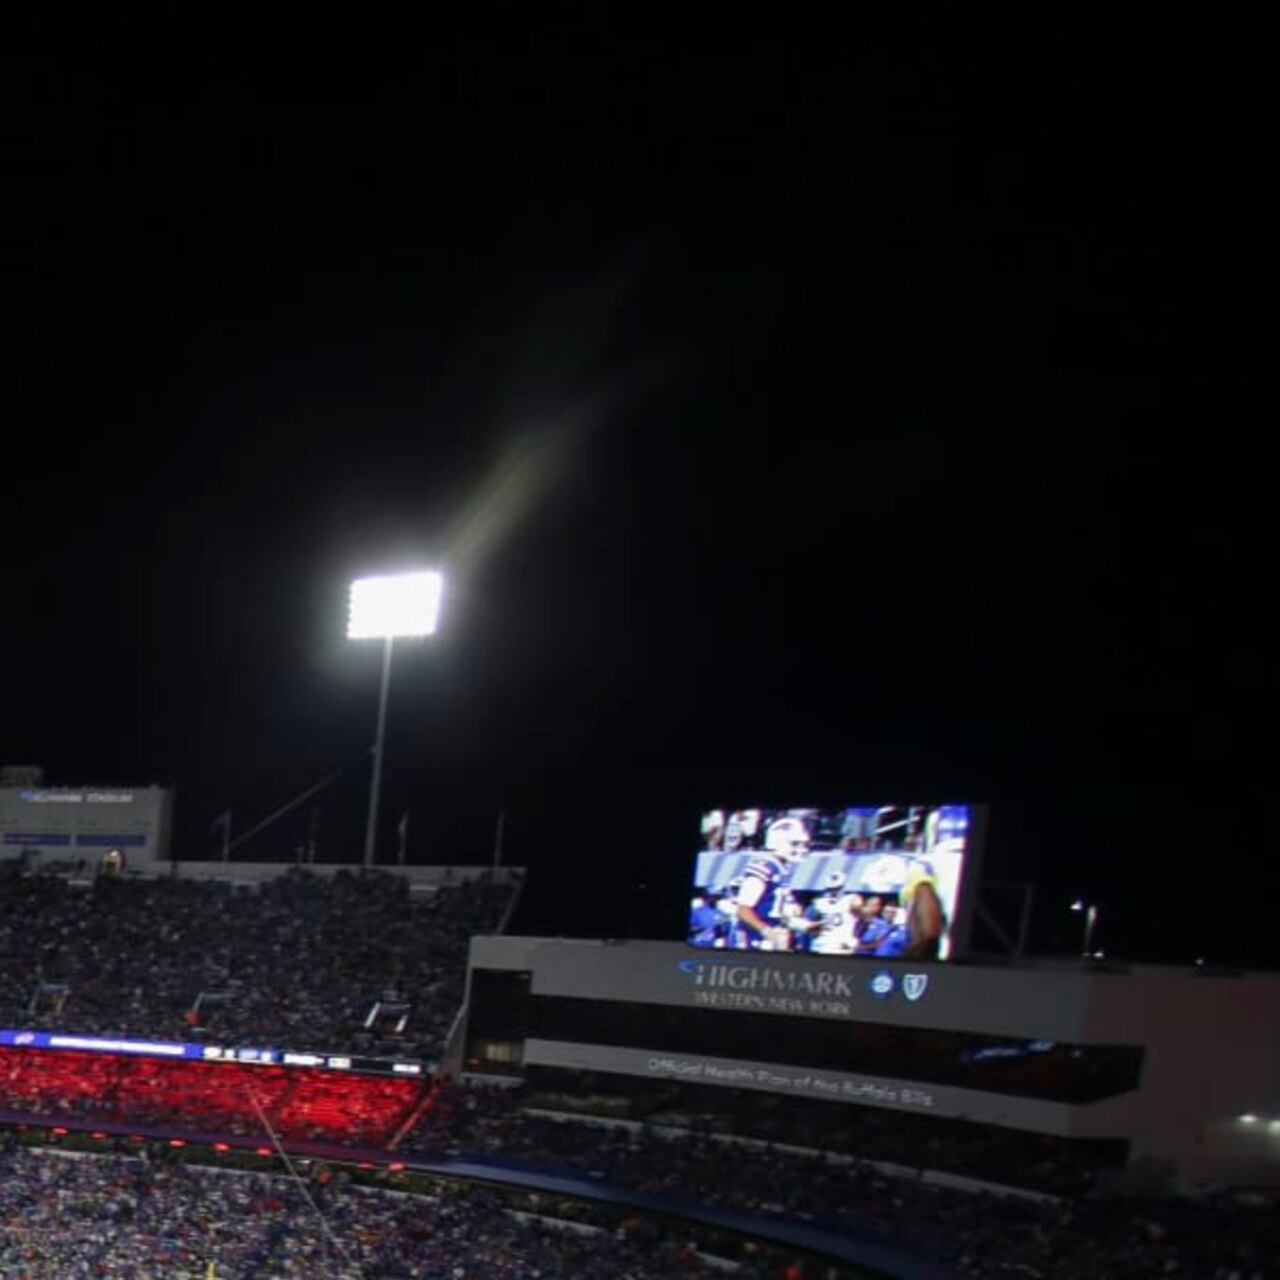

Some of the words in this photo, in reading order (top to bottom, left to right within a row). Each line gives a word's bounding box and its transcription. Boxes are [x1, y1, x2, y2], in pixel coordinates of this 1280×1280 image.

[694, 963, 853, 998] HIGHMARK
[694, 990, 764, 1009] WESTERN
[769, 995, 805, 1012] NEW
